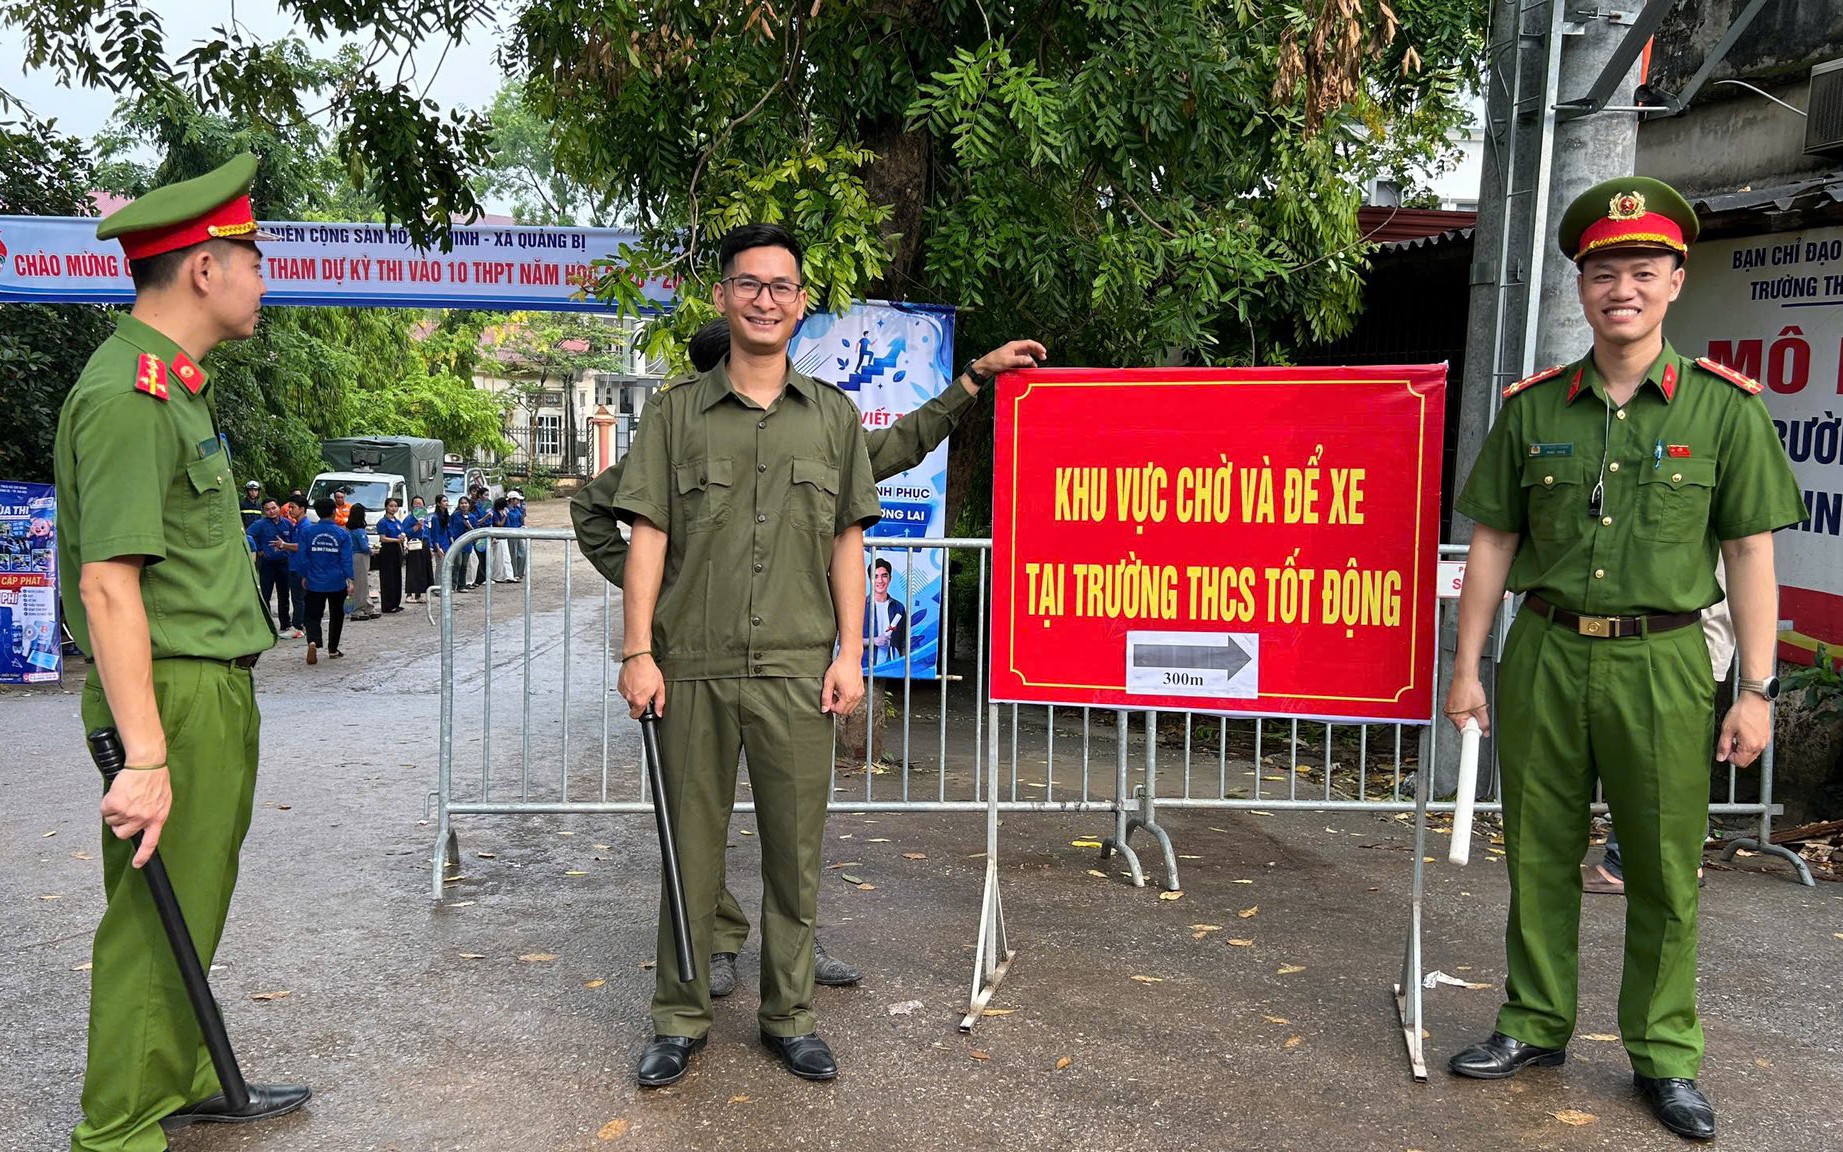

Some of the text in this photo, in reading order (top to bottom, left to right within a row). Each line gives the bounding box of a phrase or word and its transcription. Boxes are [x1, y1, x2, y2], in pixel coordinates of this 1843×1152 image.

[309, 225, 349, 246] CỘNG
[354, 224, 384, 244] SẢN
[494, 230, 513, 247] XÃ
[518, 228, 567, 248] QUẢNG
[571, 234, 586, 251] BỊ
[1771, 236, 1802, 266] CHỈ
[1805, 239, 1842, 266] ĐẠO
[14, 250, 61, 276] CHÀO
[65, 250, 119, 277] MỪNG
[268, 257, 316, 280] THAM
[321, 257, 346, 285] DỰ
[350, 254, 372, 281] KỲ
[376, 259, 403, 281] THI
[408, 256, 441, 282] VÀO
[448, 261, 467, 283] 10
[473, 262, 514, 284] THPT
[519, 259, 559, 286] NĂM
[1750, 274, 1818, 300] TRƯỜNG
[1708, 325, 1811, 394] MÔ
[861, 407, 890, 425] VIẾT
[896, 487, 930, 501] PHỤC
[1054, 444, 1366, 535] KHU VỰC CHỜ VÀ ĐỂ XE
[12, 505, 29, 515] THI
[907, 510, 925, 521] LAI
[1025, 547, 1402, 639] TẠI TRƯỜNG THCS TỐT ĐỘNG
[1163, 672, 1203, 686] 300m
